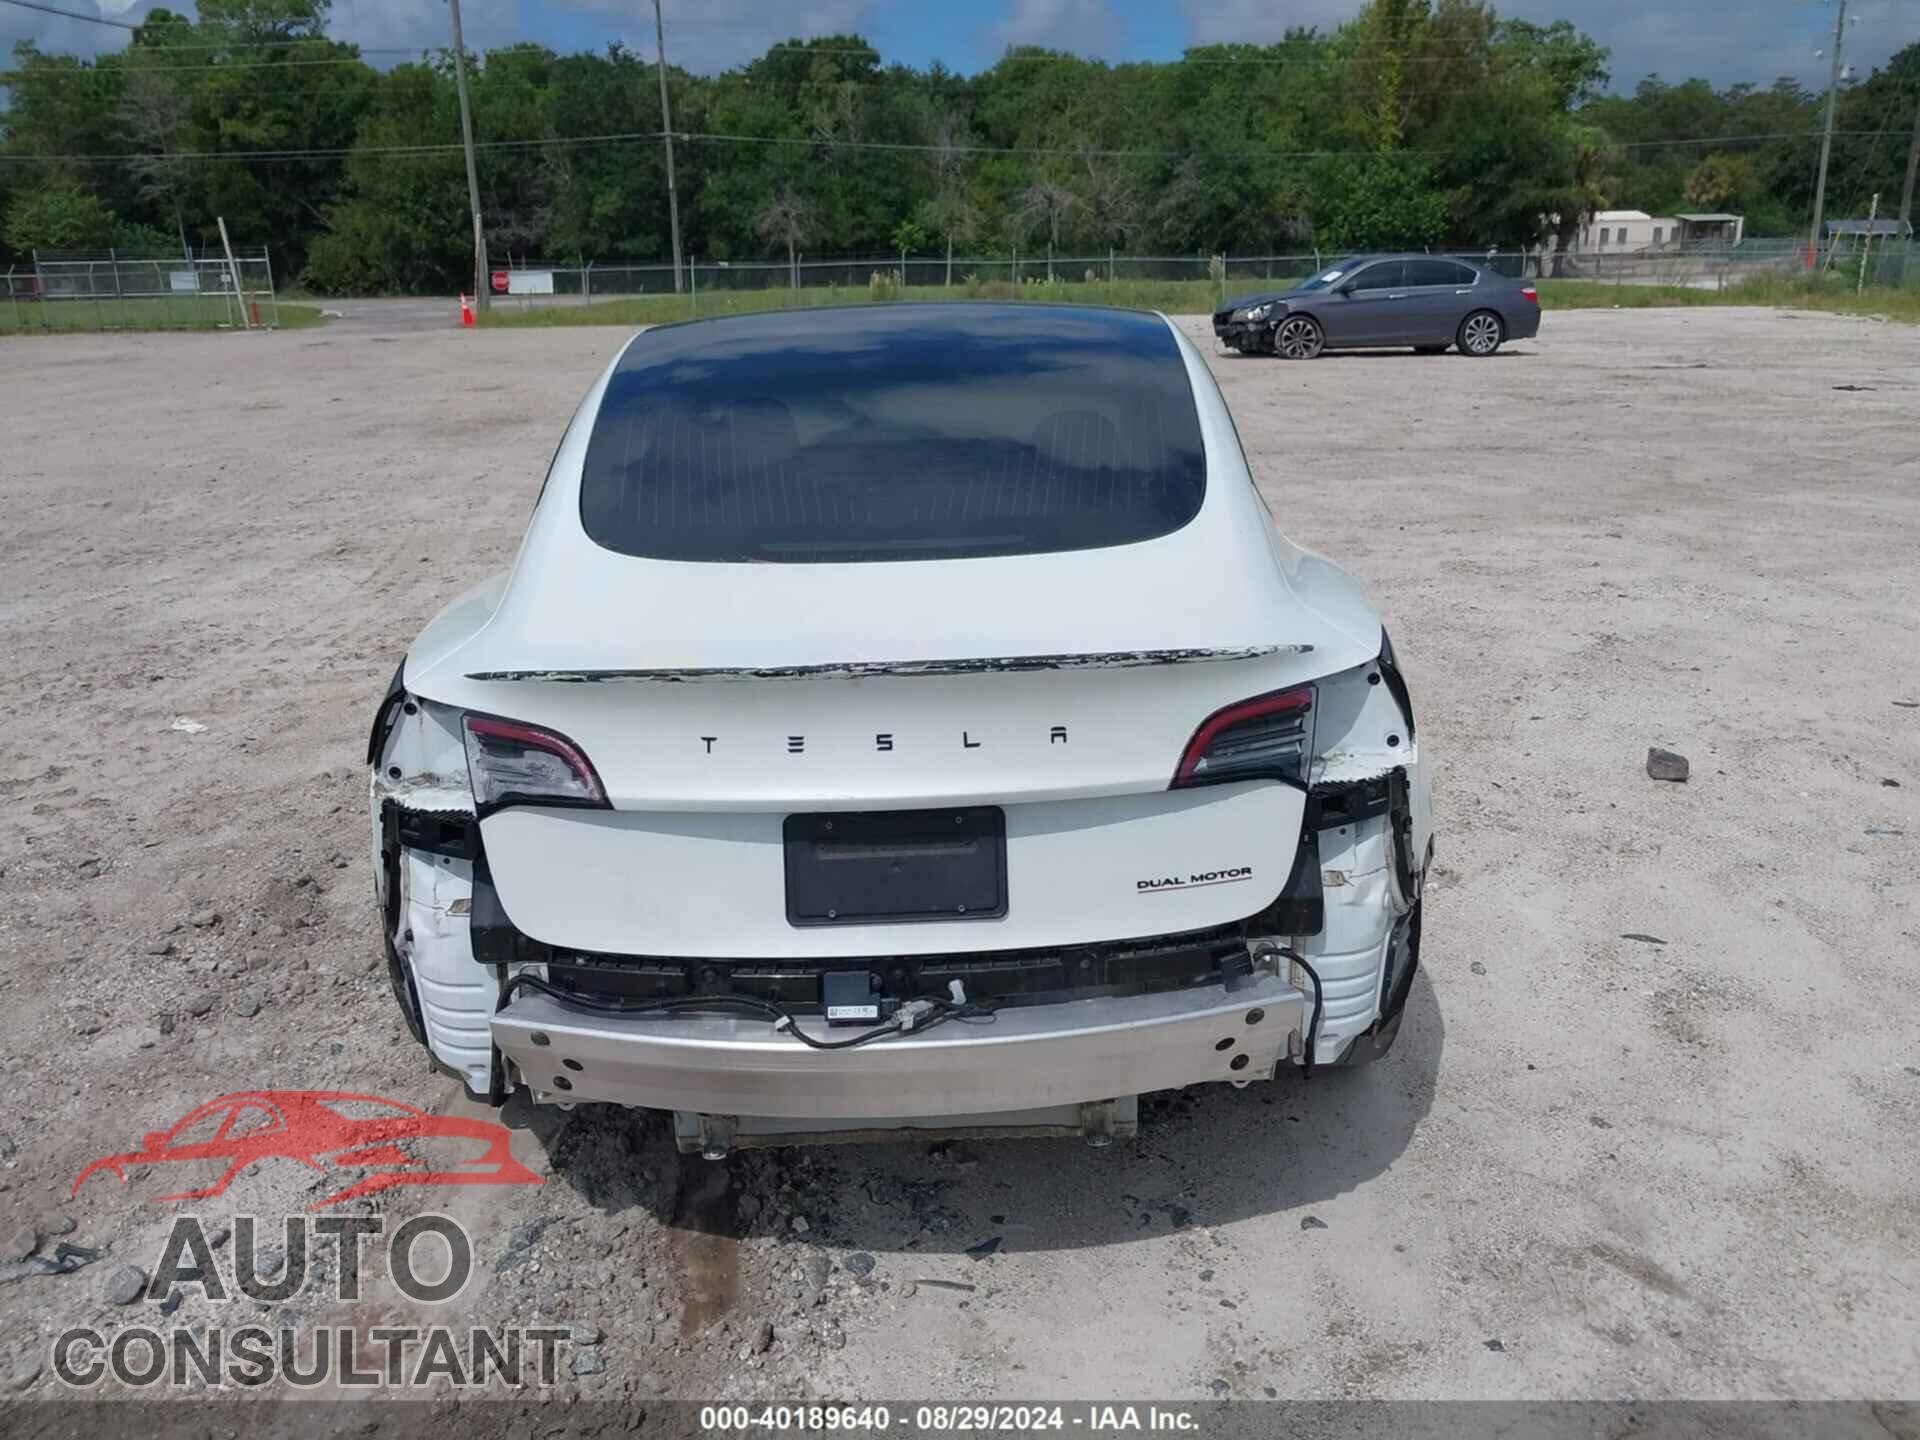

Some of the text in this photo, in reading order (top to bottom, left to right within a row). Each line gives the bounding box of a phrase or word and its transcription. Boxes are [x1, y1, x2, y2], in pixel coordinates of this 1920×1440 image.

[701, 726, 1067, 754] TESLA
[1137, 867, 1252, 889] DUAL MOTOR
